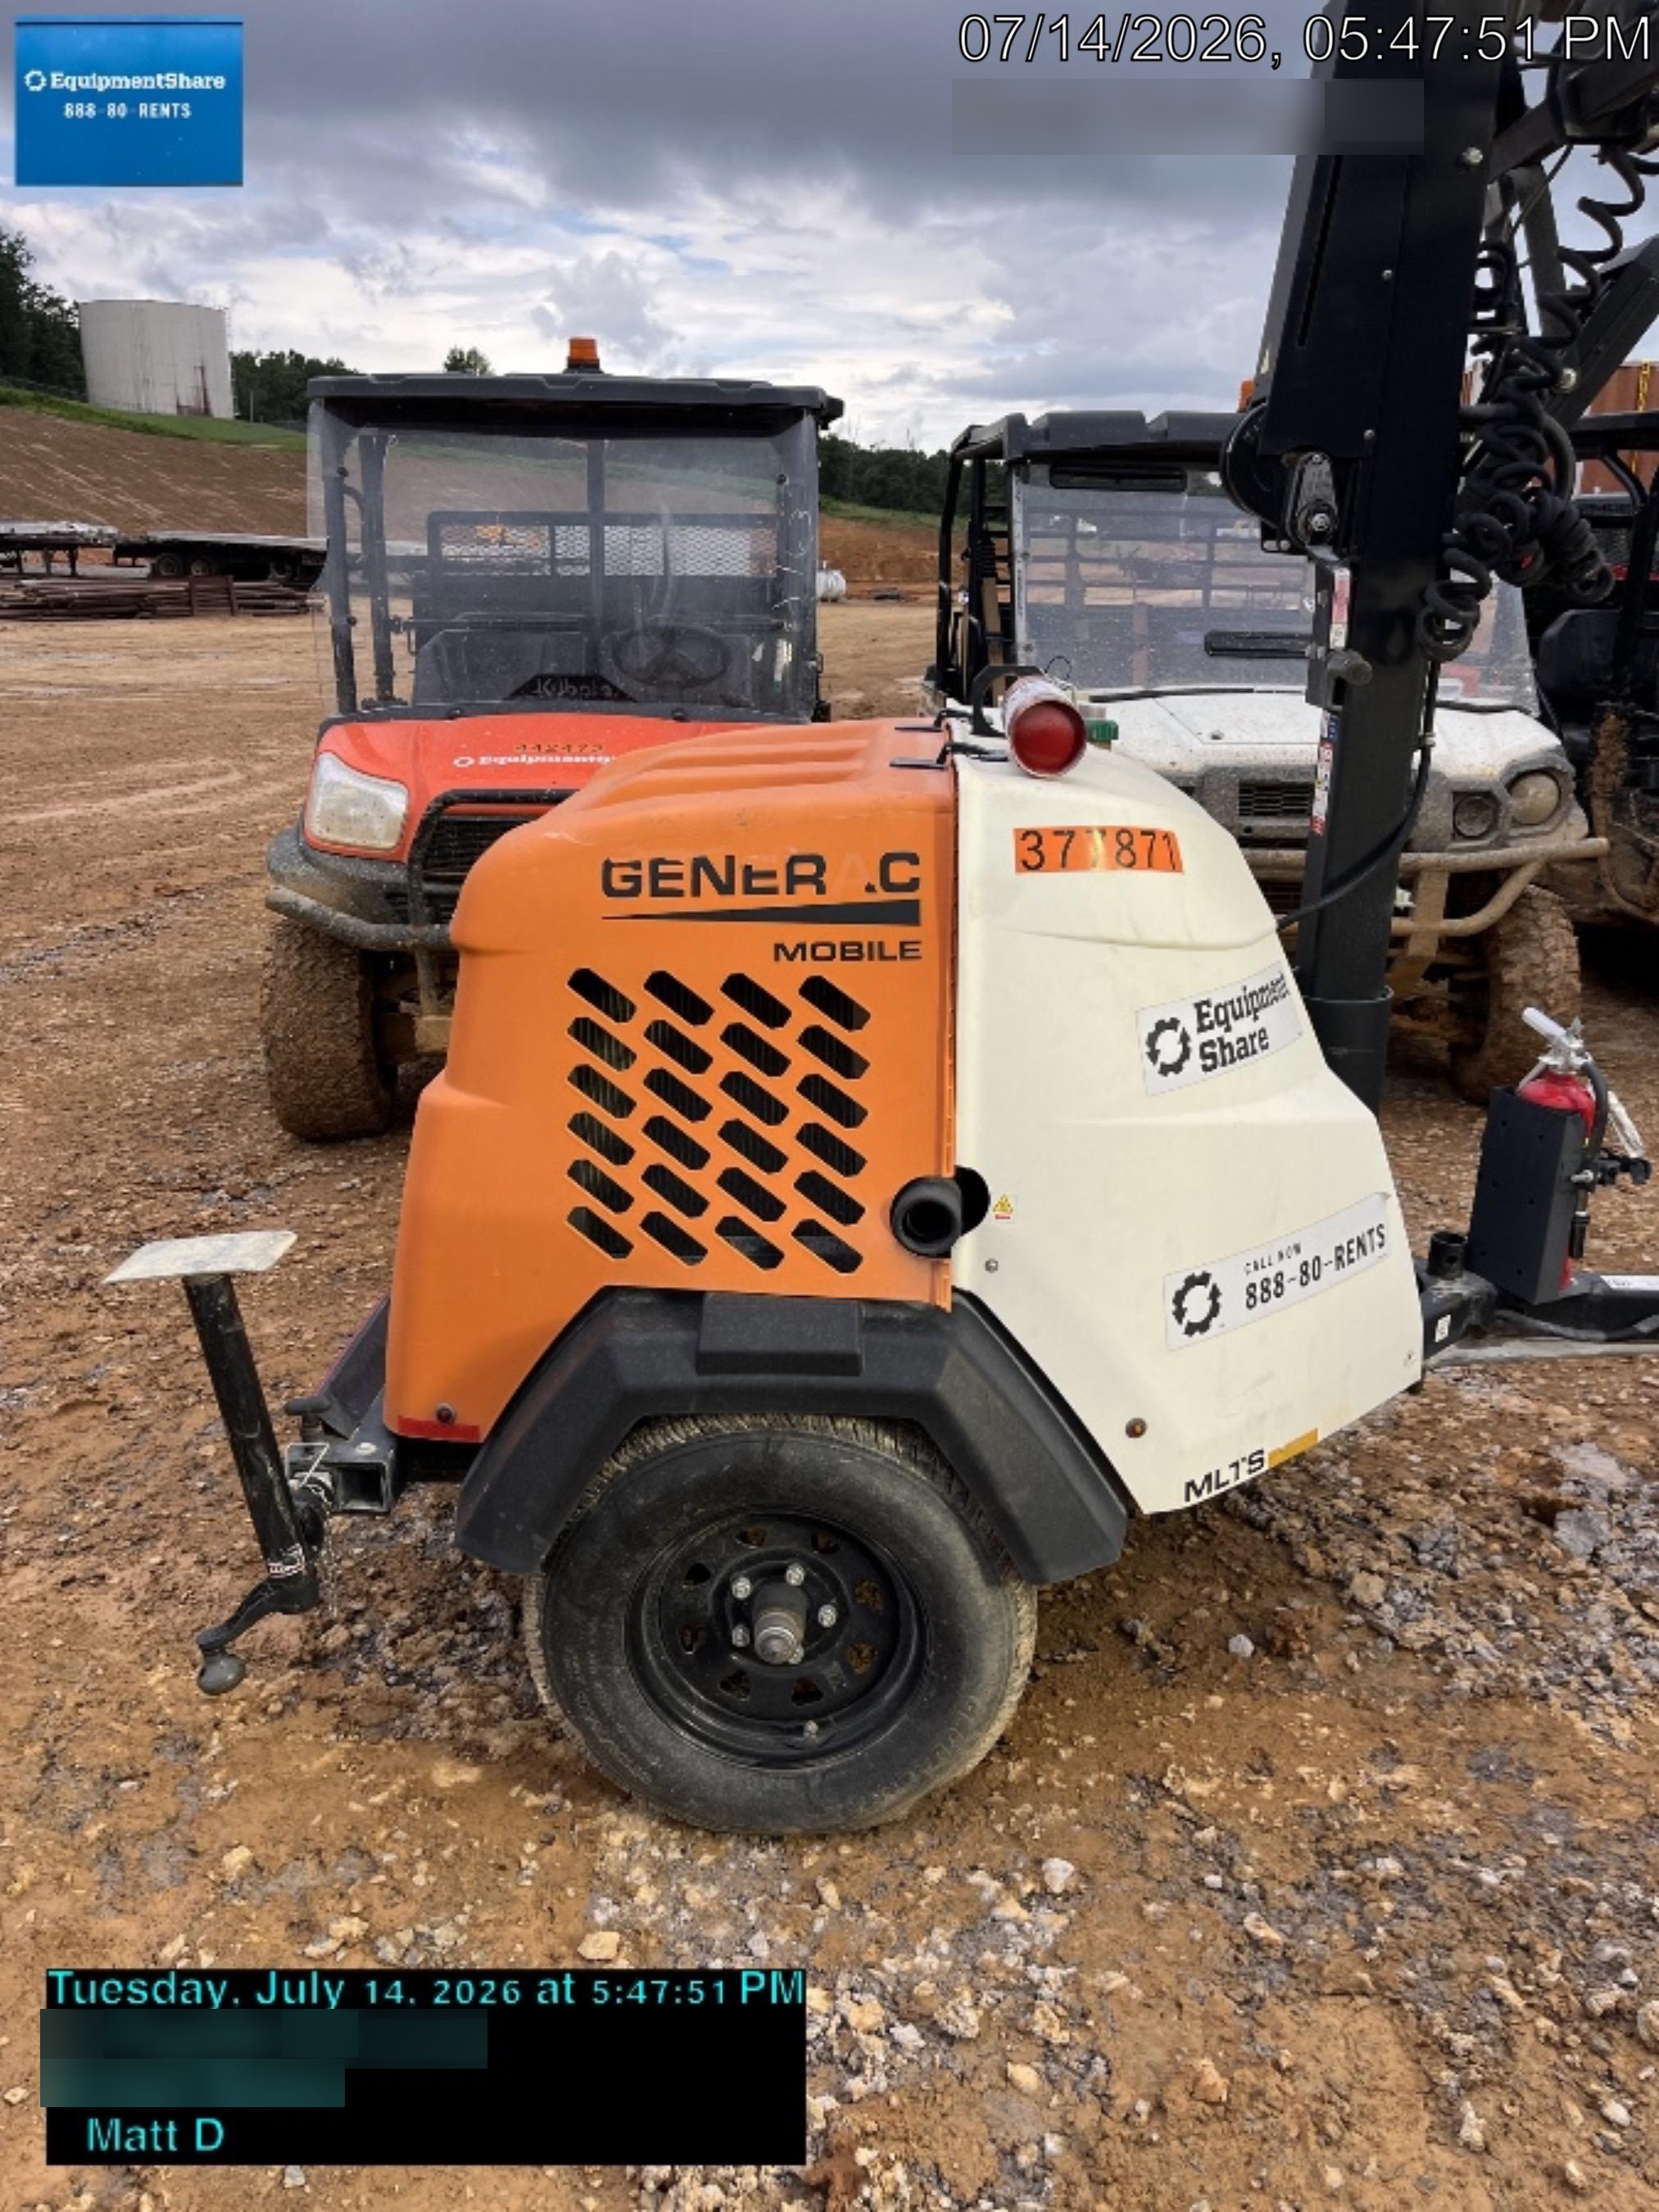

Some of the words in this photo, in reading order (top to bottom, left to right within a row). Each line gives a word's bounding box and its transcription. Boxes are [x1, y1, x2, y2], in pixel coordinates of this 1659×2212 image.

[601, 852, 921, 898] GENERC
[773, 941, 922, 962] MOBILE
[1194, 971, 1292, 1035] Equipment
[1199, 1027, 1269, 1072] Share
[1244, 1253, 1273, 1276] CALL
[1245, 1224, 1385, 1310] 888-80-RENTS
